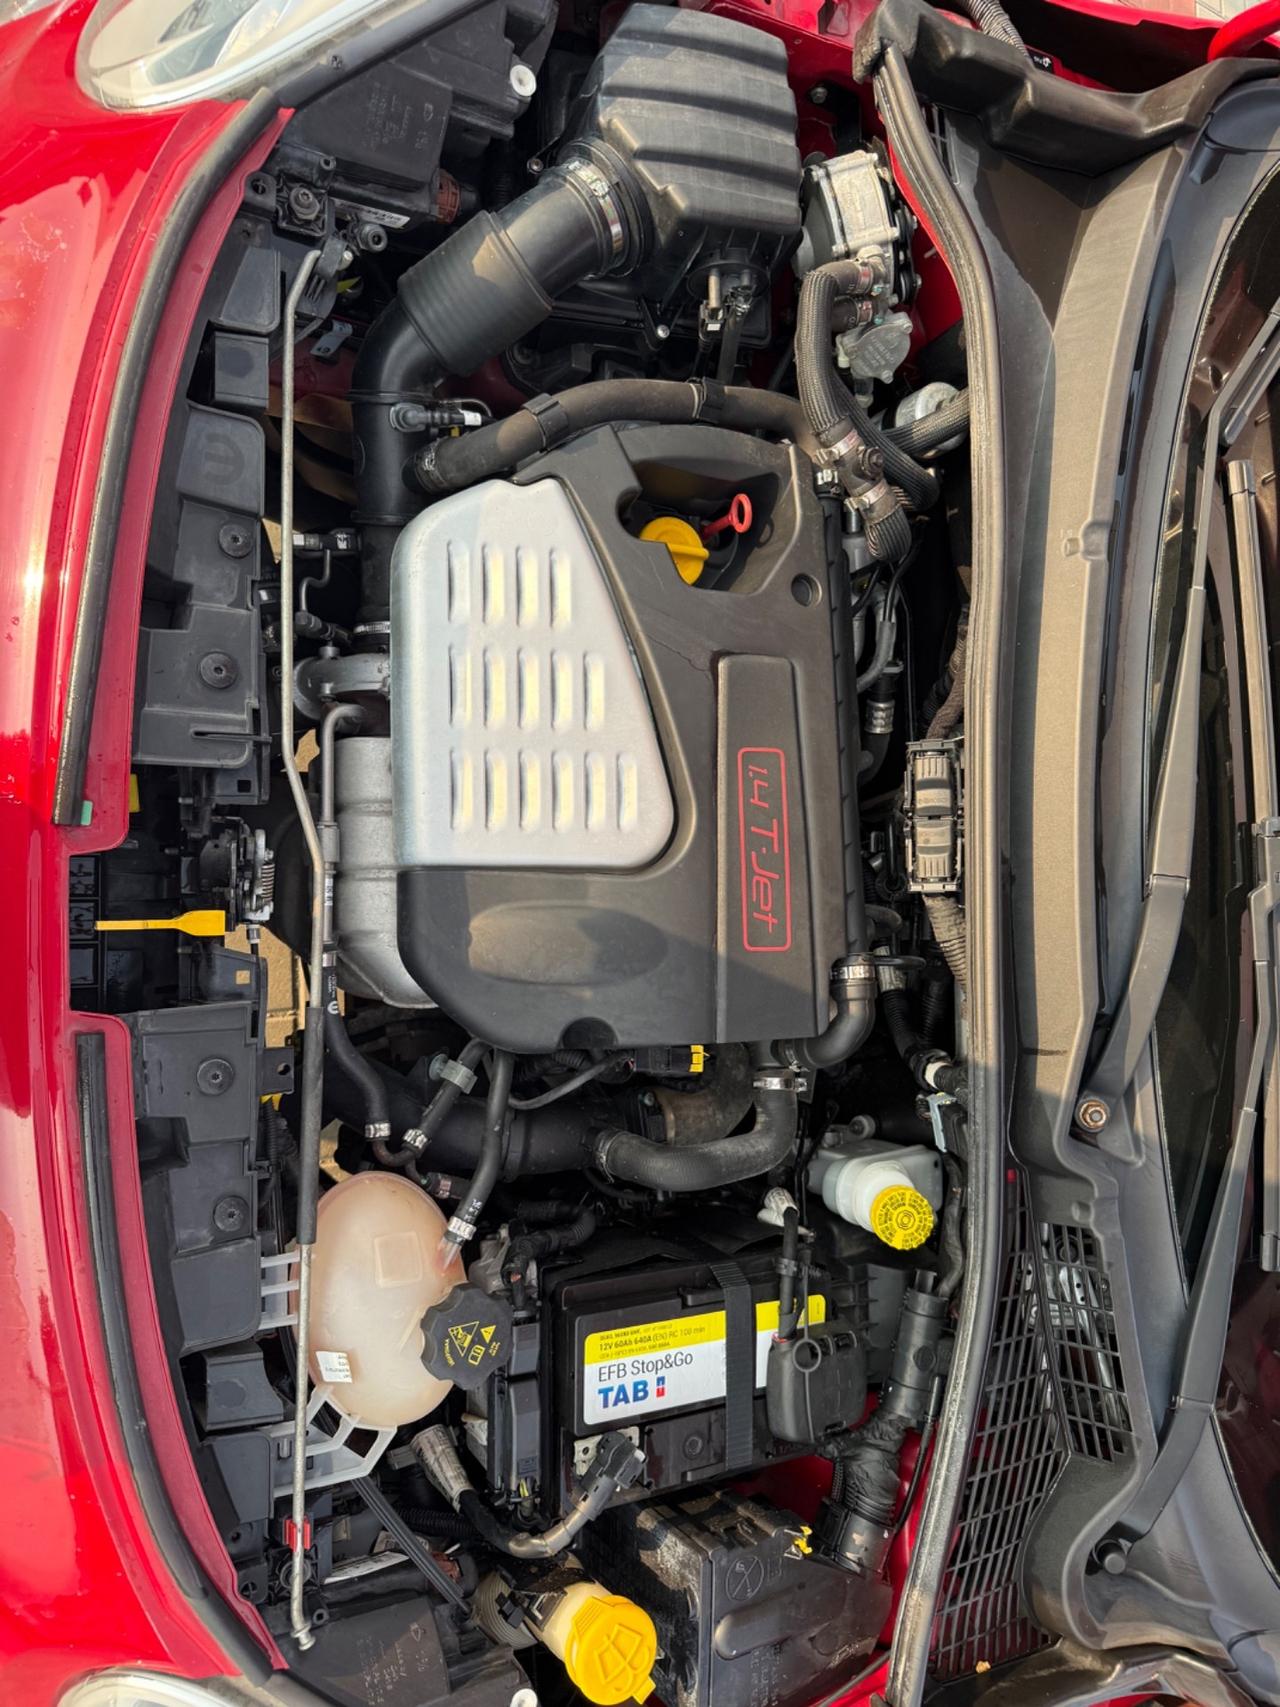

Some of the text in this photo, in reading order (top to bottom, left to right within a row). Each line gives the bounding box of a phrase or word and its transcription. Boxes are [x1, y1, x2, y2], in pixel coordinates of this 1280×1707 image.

[748, 764, 769, 809] 1.4
[599, 1342, 614, 1351] 12V
[614, 1338, 633, 1347] 60Ah
[668, 1329, 679, 1338] RC
[598, 1362, 628, 1382] EFB
[630, 1350, 694, 1375] Stop&Go
[597, 1379, 650, 1409] TAB
